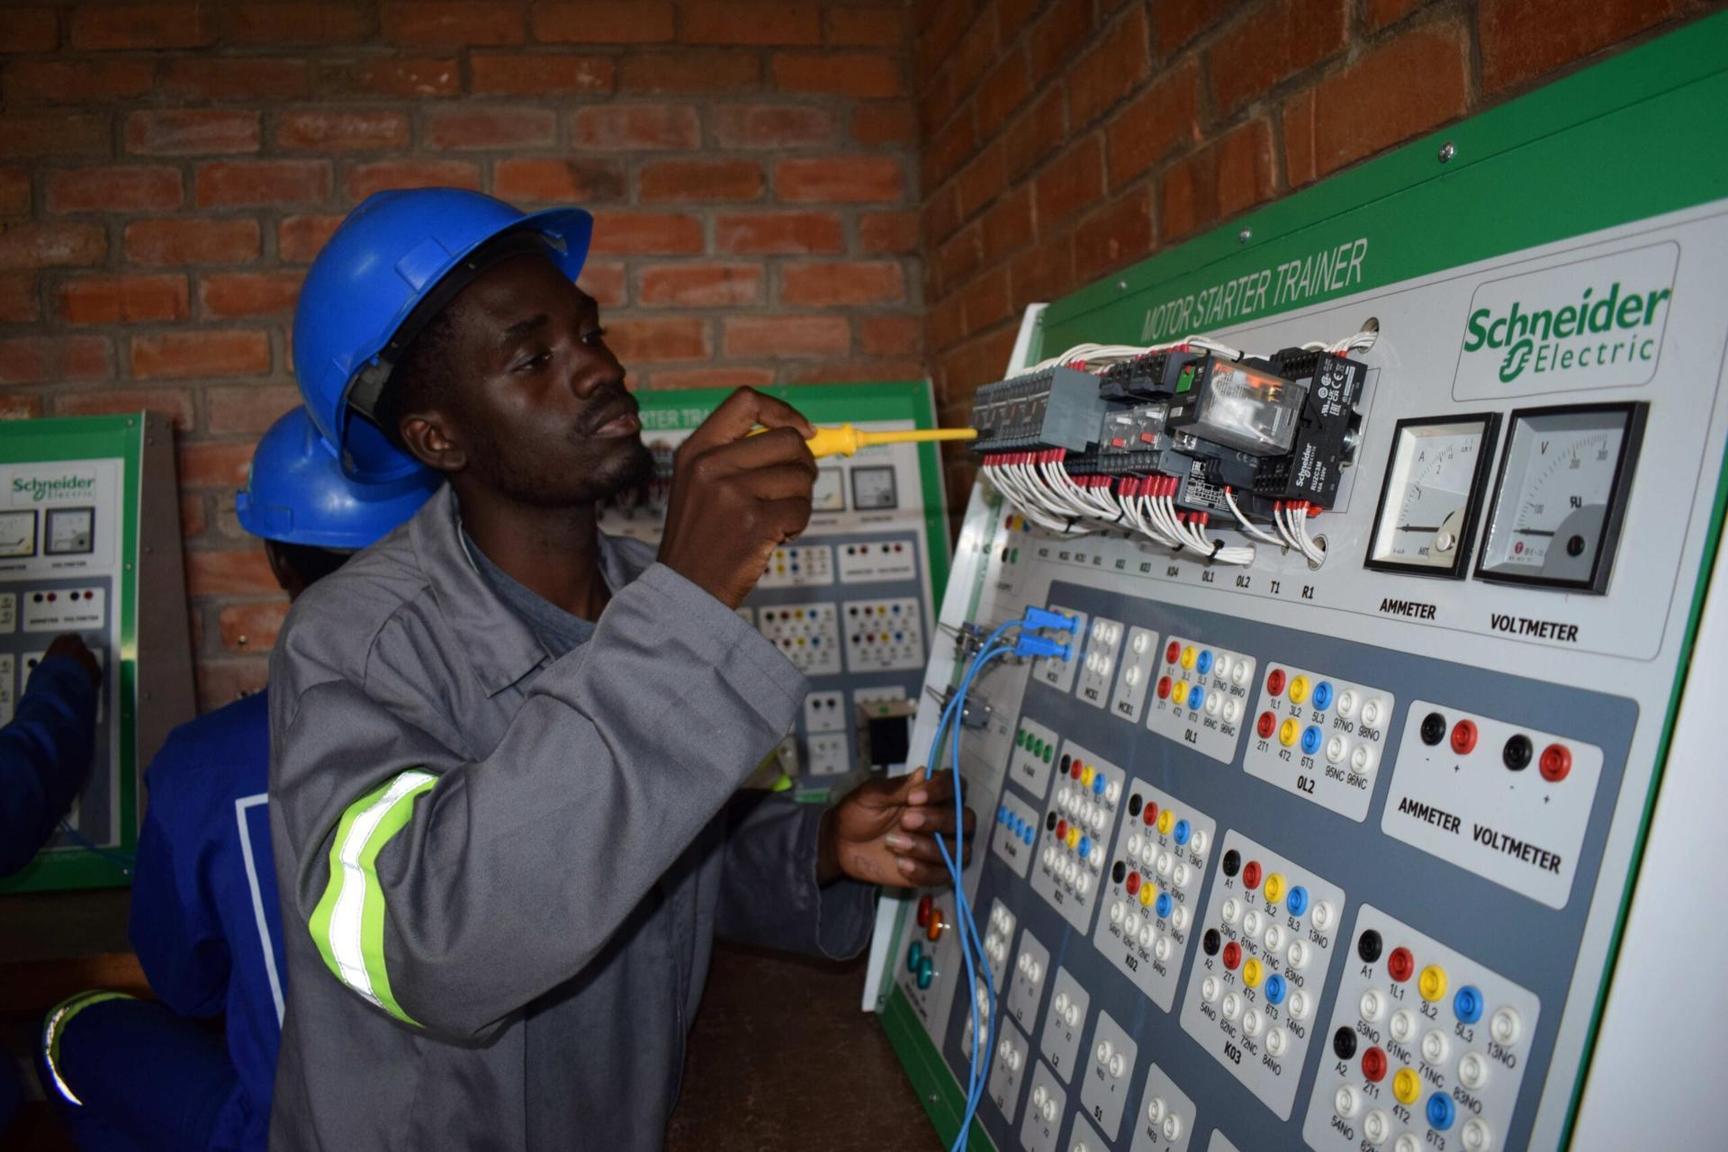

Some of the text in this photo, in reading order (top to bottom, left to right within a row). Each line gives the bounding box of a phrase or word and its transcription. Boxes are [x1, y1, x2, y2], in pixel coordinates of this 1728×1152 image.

[1141, 238, 1368, 342] MOTOR STARTER TRAINER
[1464, 282, 1673, 352] Schneider
[1534, 334, 1654, 372] Electric
[1296, 442, 1312, 487] Schneider
[1541, 441, 1549, 455] V
[13, 475, 93, 492] Schneider
[1236, 575, 1250, 588] OL2
[1270, 580, 1280, 594] T1
[1302, 585, 1314, 599] R1
[1380, 598, 1578, 642] AMMETER VOLTMETER
[1269, 699, 1380, 742] 1L1 3L2 5L3 97NO 98NO
[1257, 740, 1368, 790] 2T1 4T2 6T3 95NC 96NC
[1297, 775, 1315, 794] OL2
[1398, 797, 1562, 875] AMMETER VOLTMETER
[1224, 878, 1328, 949] A1 1L1 3L2 5L3 13NO
[1220, 923, 1304, 988] 53NO 61NC 71NC 83NO
[1204, 959, 1305, 1039] A2 2T1 4T2 6T3 14NO
[1360, 965, 1516, 1069] A1 1L1 3L2 5L3 13NO
[1200, 1003, 1281, 1076] 54NO 62NC 72NC 84NO
[1224, 1040, 1242, 1065] K03
[1357, 1020, 1483, 1116] 53NO 61NC 71NC 83NO
[1330, 1115, 1354, 1141] 54NO
[1335, 1061, 1446, 1150] A2 2T1 4T2 6T3
